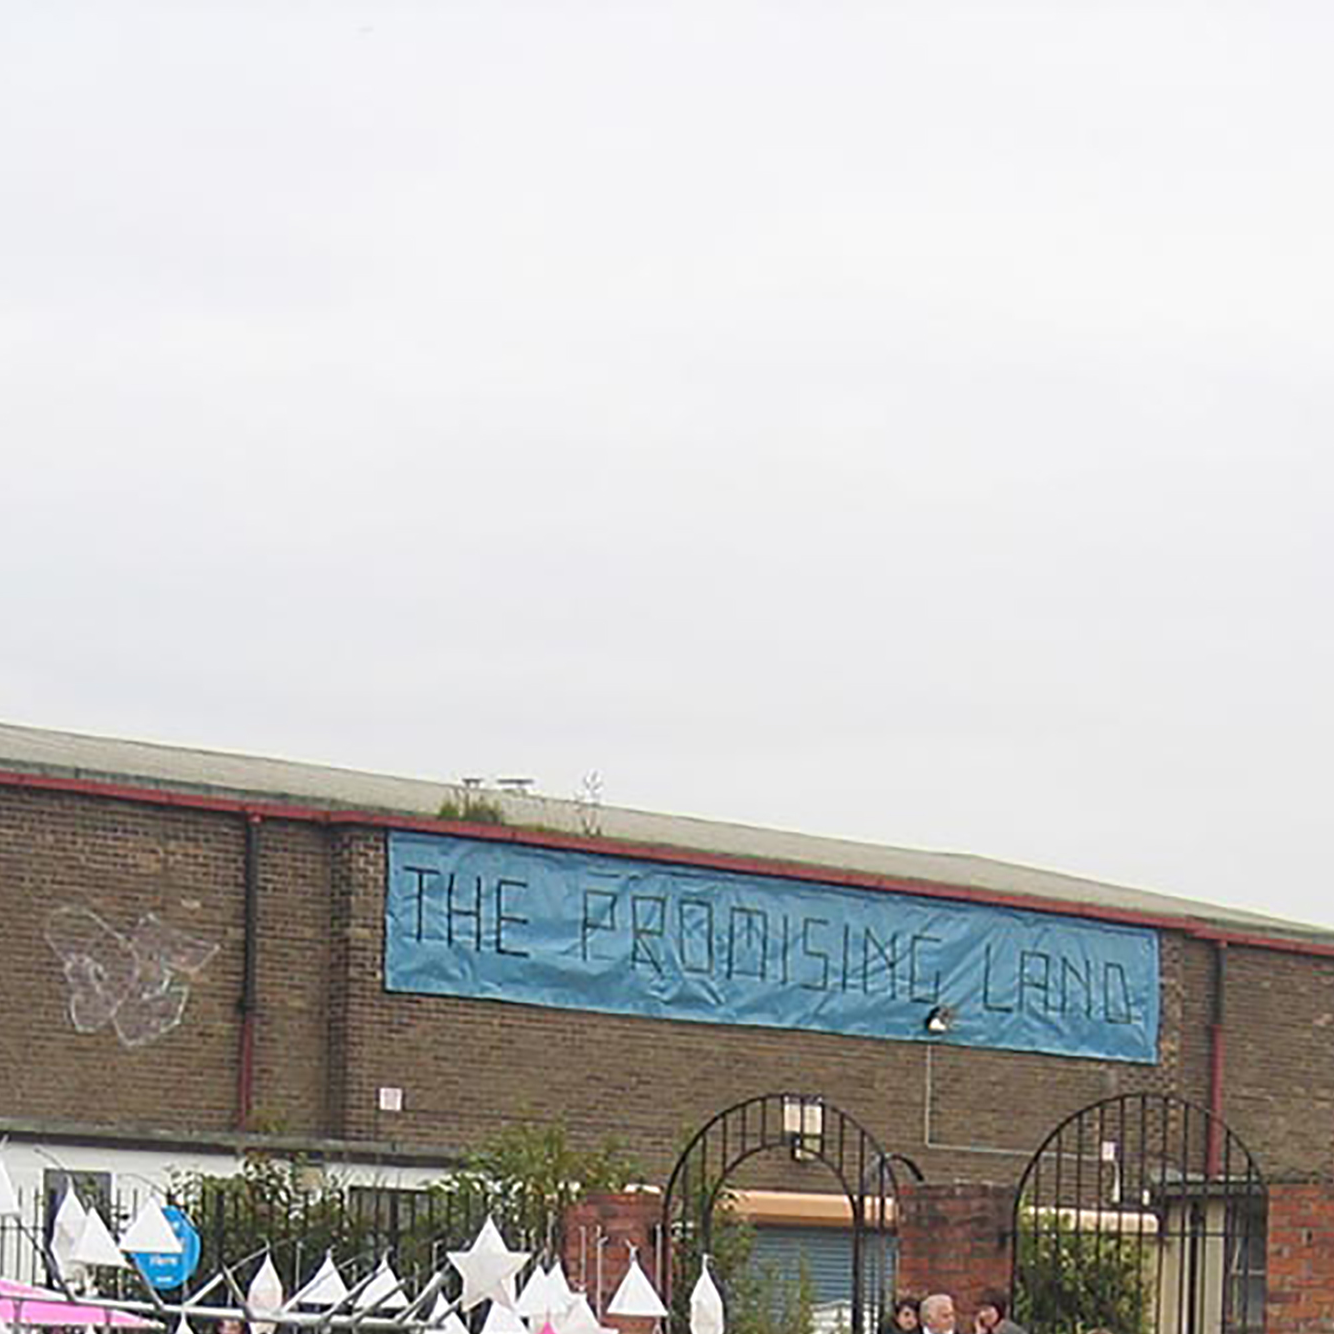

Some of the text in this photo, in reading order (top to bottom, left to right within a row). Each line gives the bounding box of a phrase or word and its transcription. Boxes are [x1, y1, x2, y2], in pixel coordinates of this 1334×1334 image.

[404, 866, 1134, 1025] THE PROMISING LAND
